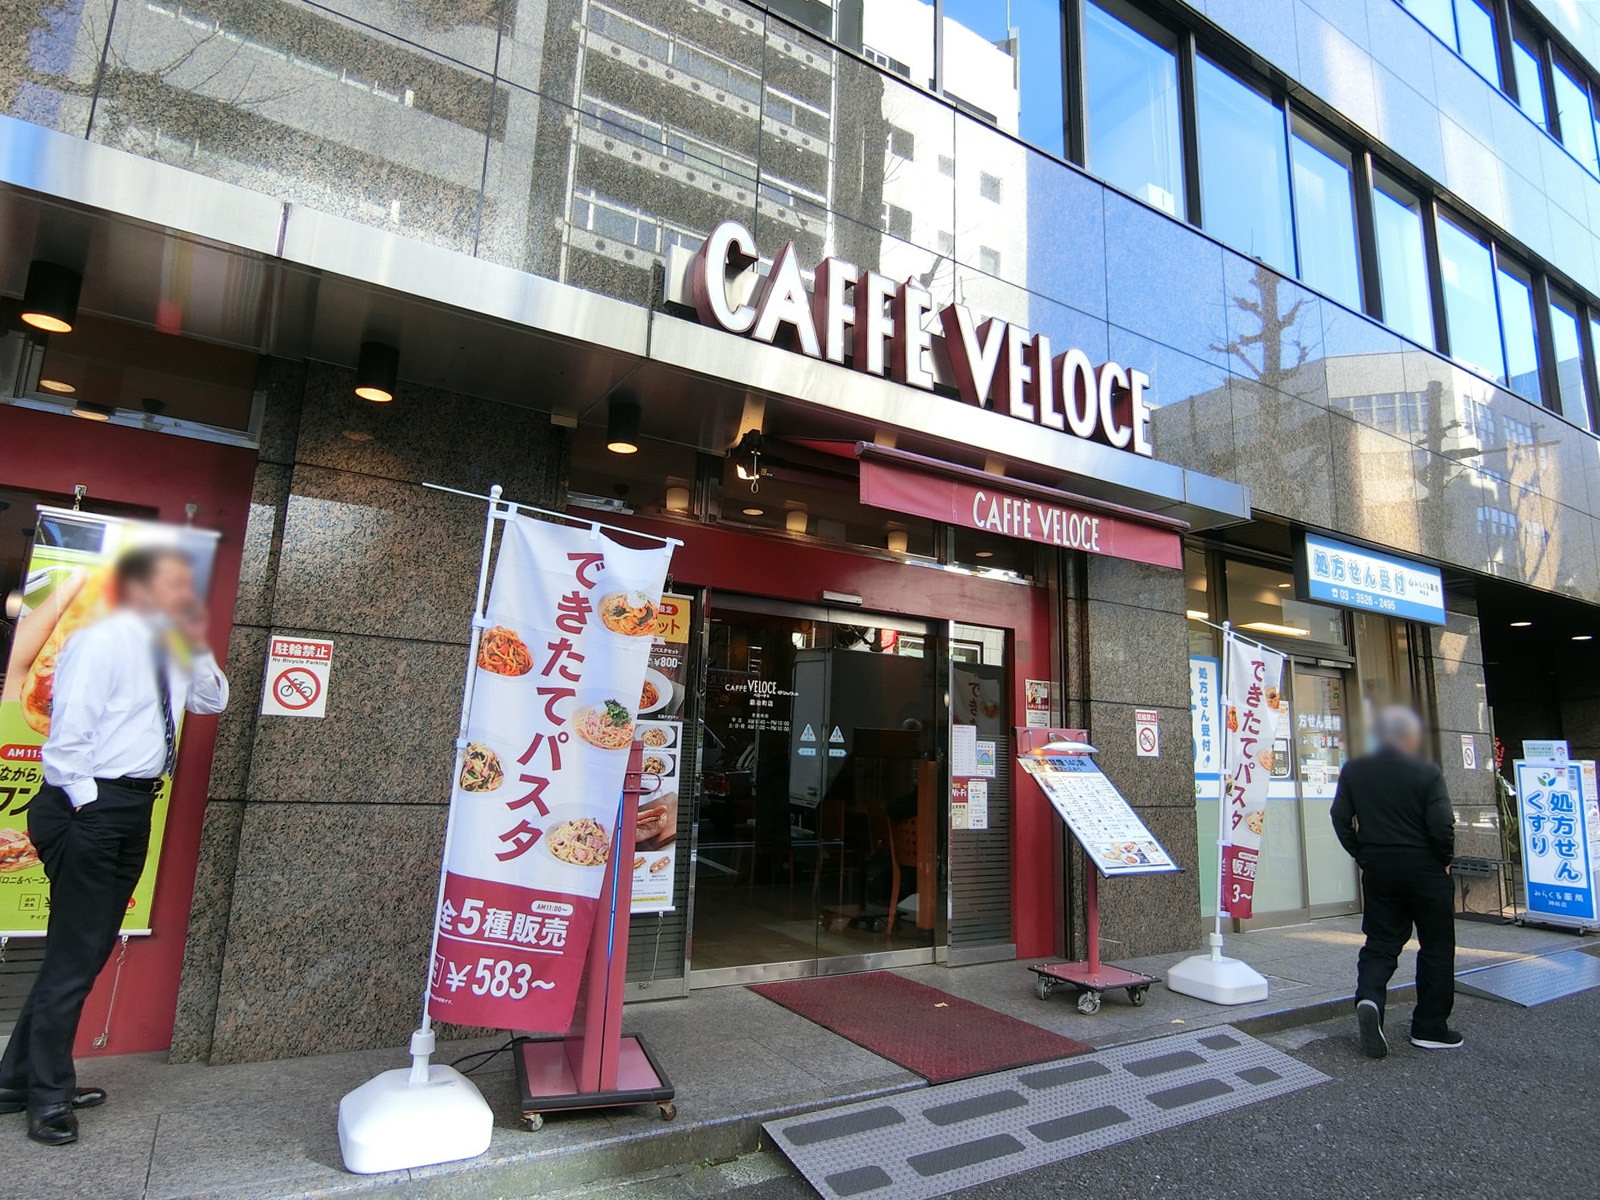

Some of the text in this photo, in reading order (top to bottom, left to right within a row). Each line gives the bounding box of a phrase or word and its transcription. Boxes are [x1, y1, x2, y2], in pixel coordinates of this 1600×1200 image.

[948, 303, 1153, 458] VELOCE
[973, 491, 1100, 552] CAFFÈ VELOCE
[1313, 550, 1406, 595] 処方せん受付
[274, 642, 329, 658] 駐輪禁止
[494, 552, 606, 862] できたてパスタ
[747, 679, 777, 694] VELOCE
[1198, 666, 1212, 752] 処方せん受付
[8, 748, 24, 757] AM
[1231, 660, 1266, 832] できたてパスタ
[1527, 791, 1549, 857] くすり
[1549, 791, 1580, 881] 処方せん
[0, 876, 51, 886] ロニ&ベーコ
[440, 898, 569, 947] 全5種販売
